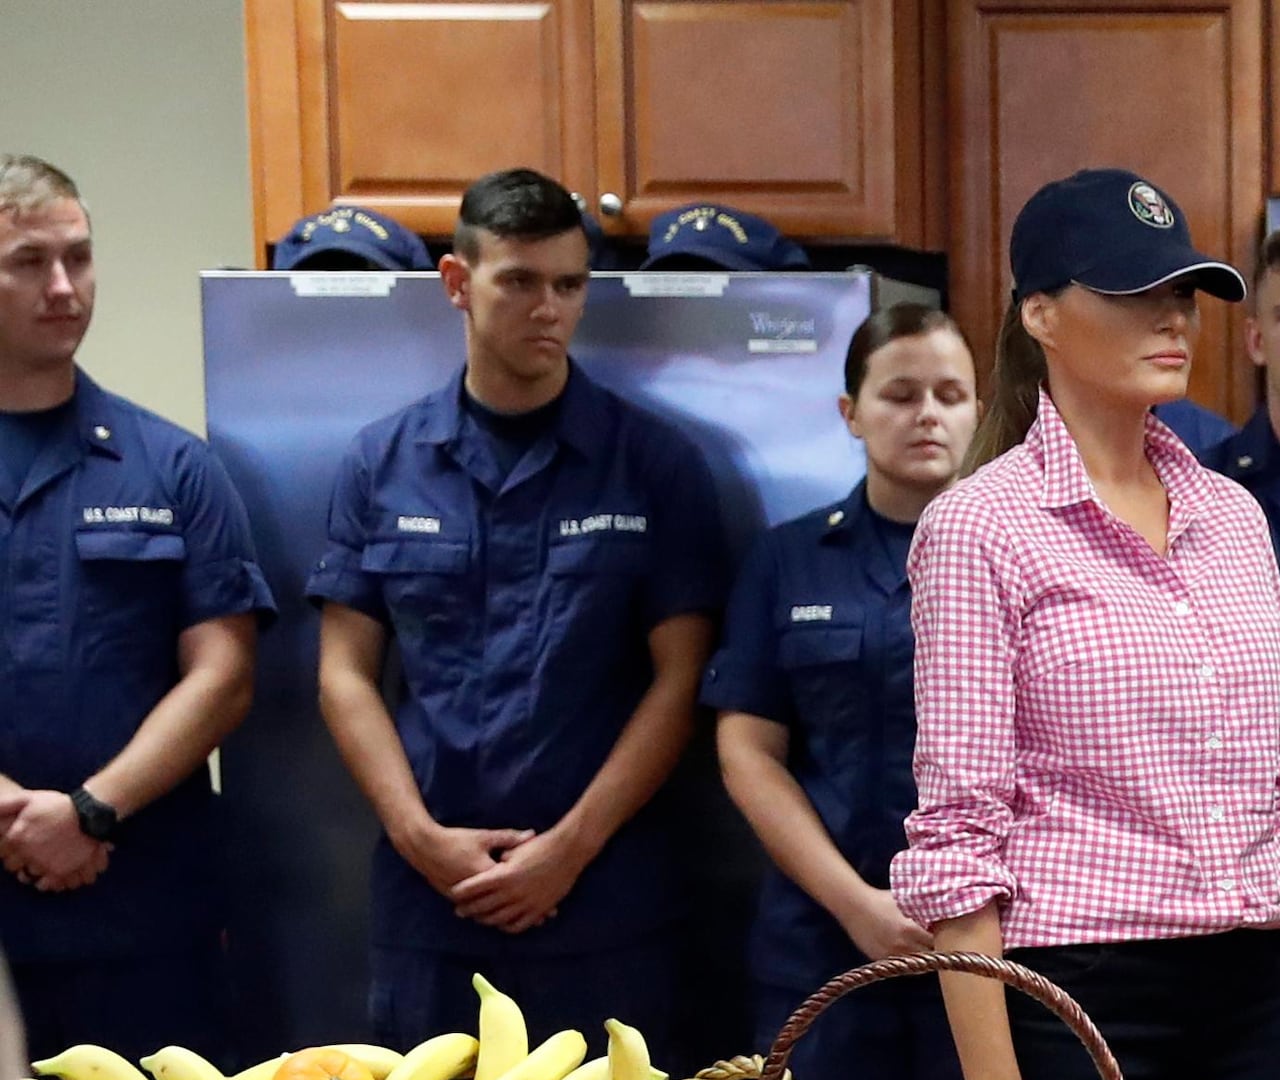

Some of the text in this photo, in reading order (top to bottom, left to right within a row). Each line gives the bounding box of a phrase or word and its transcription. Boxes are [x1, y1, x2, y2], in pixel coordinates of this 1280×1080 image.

[105, 506, 139, 523] COAST
[139, 507, 174, 526] GUARD
[580, 514, 614, 534] COAST
[613, 514, 648, 534] GUARD
